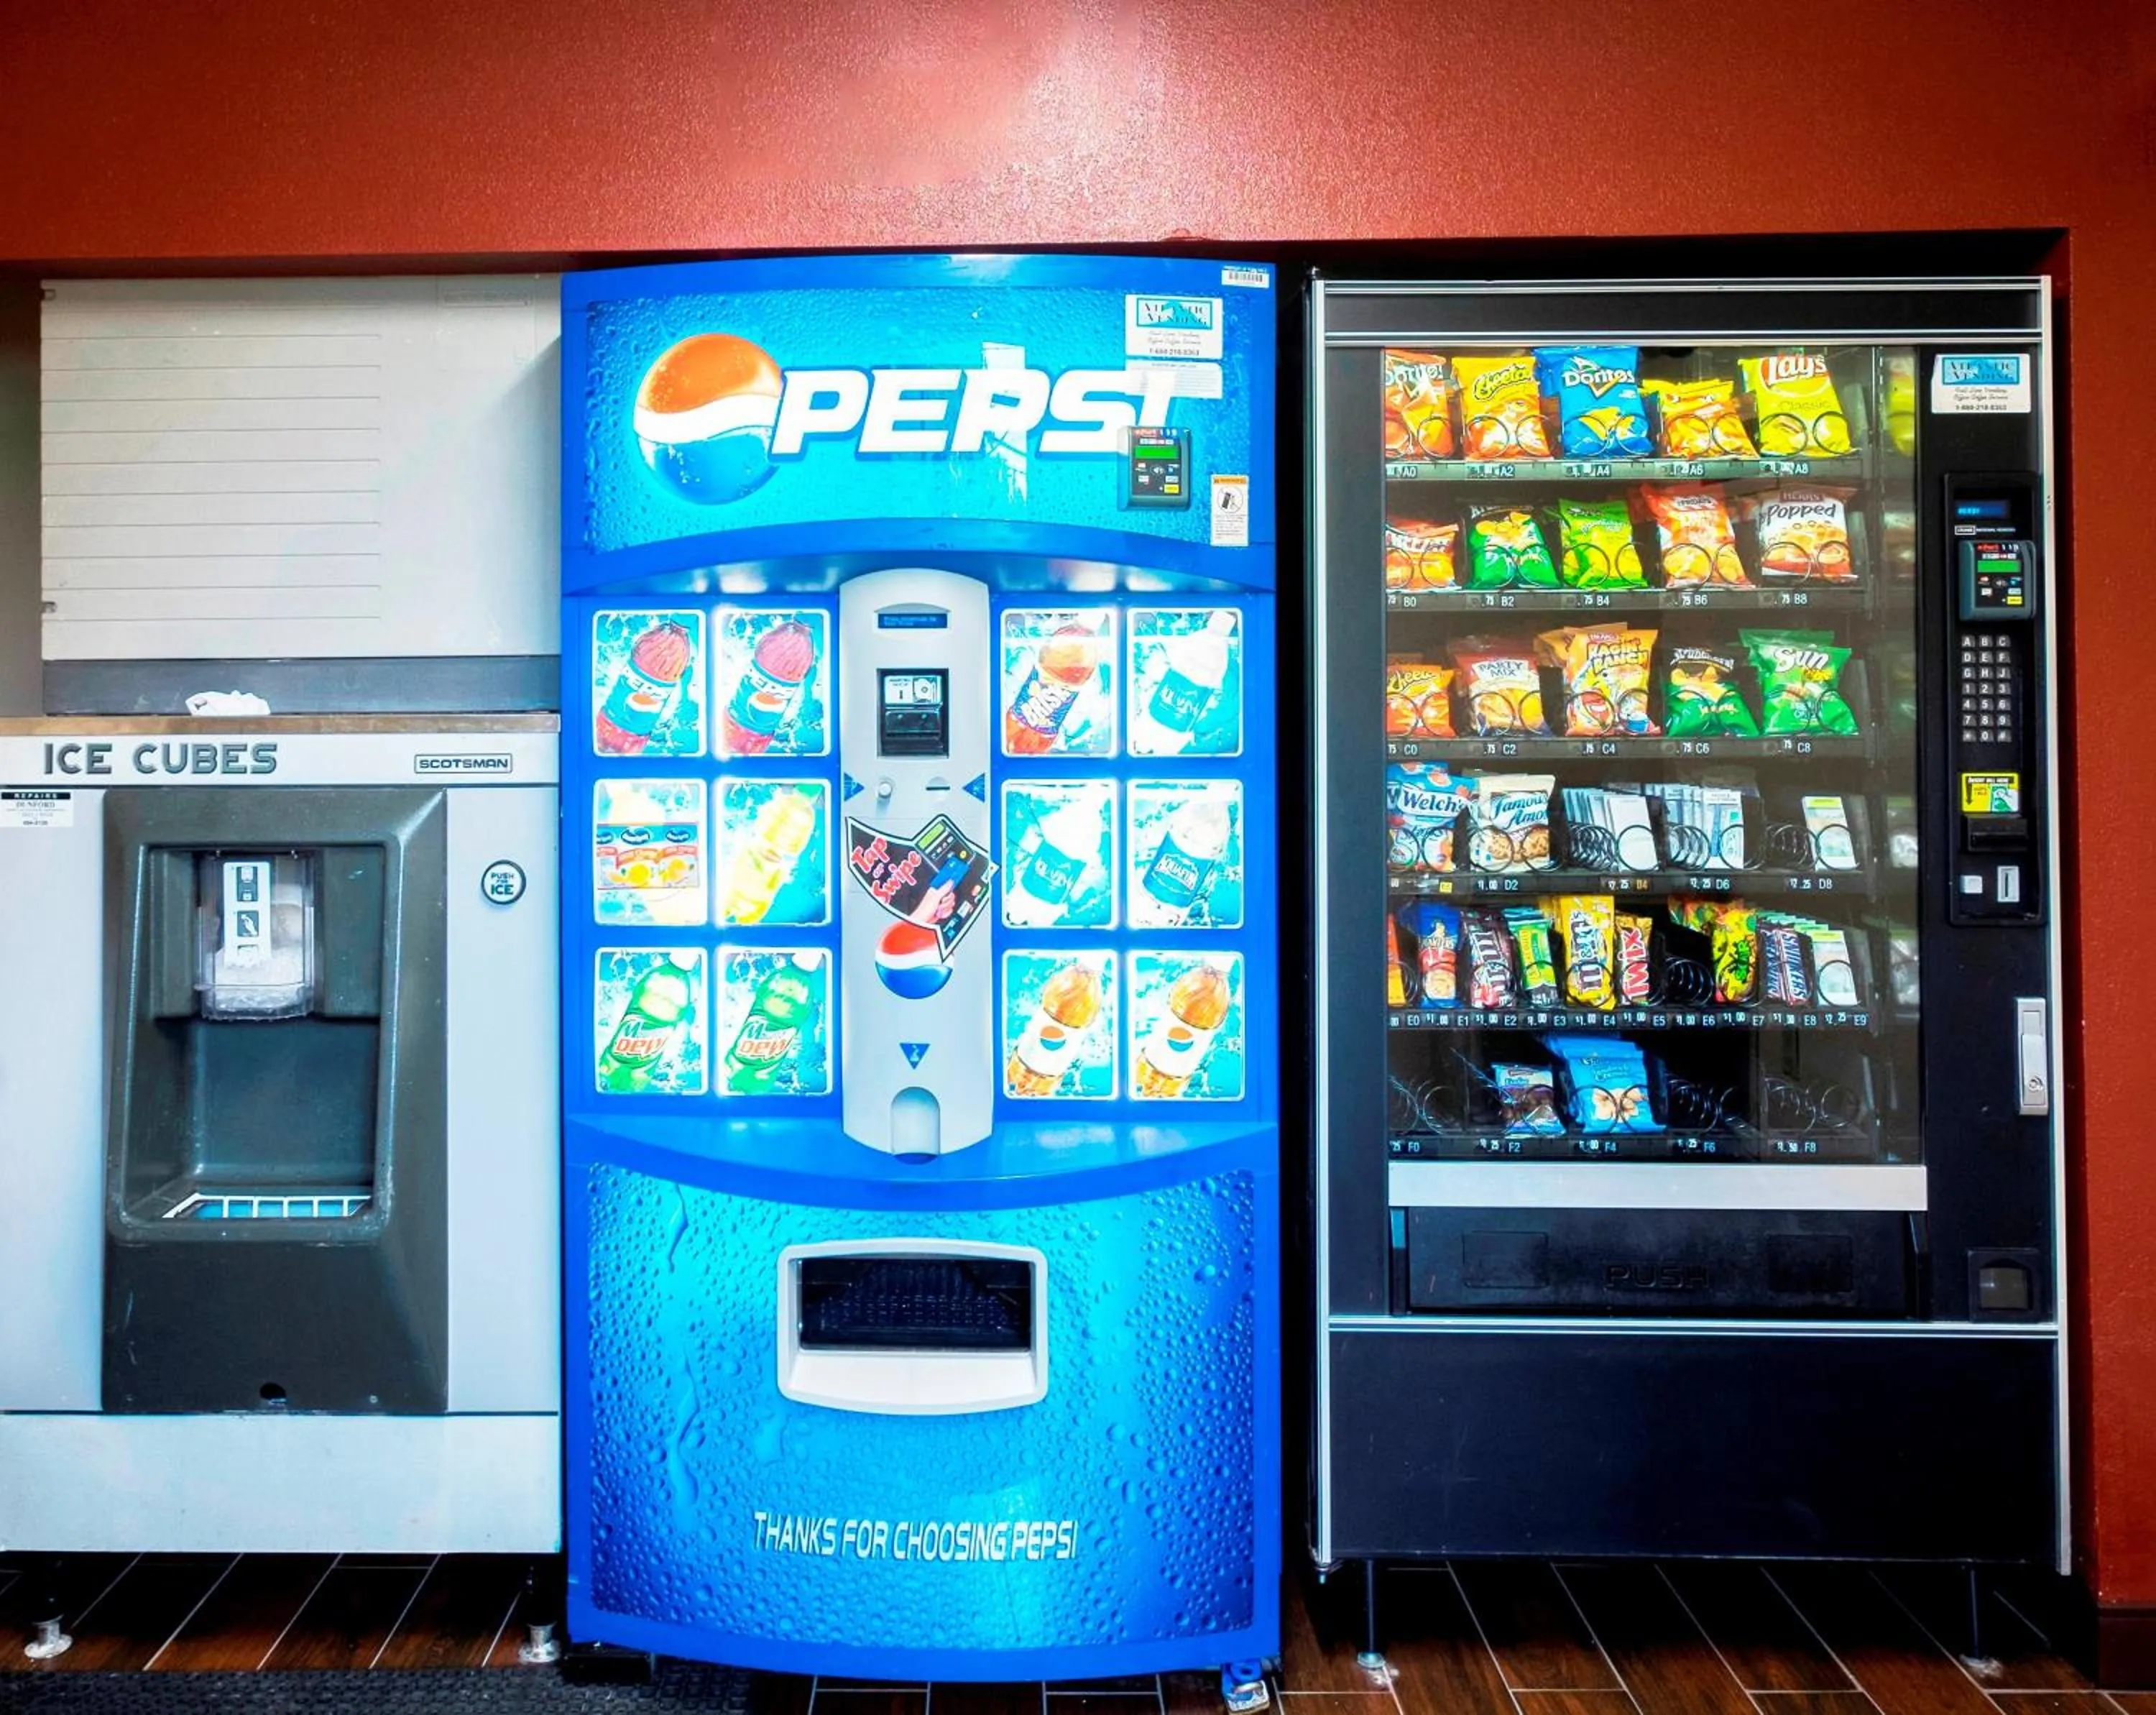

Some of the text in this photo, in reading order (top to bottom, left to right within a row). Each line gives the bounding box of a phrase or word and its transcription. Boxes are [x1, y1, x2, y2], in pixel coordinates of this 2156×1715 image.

[1564, 367, 1635, 387] Doritos
[1402, 466, 1416, 478] A0
[1500, 466, 1514, 477] A2
[1596, 465, 1611, 477] A4
[1690, 464, 1704, 476] A6
[1795, 463, 1809, 474] A8
[1767, 504, 1836, 524] Popped
[1404, 596, 1416, 607] B0
[1501, 595, 1514, 607] B2
[1596, 595, 1610, 606] B4
[1694, 594, 1708, 605] B6
[1794, 594, 1807, 604] B8
[1963, 638, 2006, 646] A B C
[1774, 648, 1829, 672] Sun
[1964, 653, 2006, 662] D E F
[1478, 660, 1525, 673] PARTY
[1491, 668, 1516, 679] MIX
[1964, 668, 2006, 678] G H J
[1981, 684, 1989, 694] 2
[1999, 684, 2006, 694] 3
[1963, 700, 2006, 709] 4 5 6
[1964, 715, 1971, 725] 7
[1999, 715, 2006, 725] 9
[1981, 731, 1989, 740] 0
[1404, 744, 1418, 755] C0
[1503, 744, 1516, 755] C2
[1602, 743, 1616, 755] C4
[1695, 742, 1710, 754] C6
[1797, 742, 1811, 753] C8
[44, 742, 278, 775] ICE CUBES
[419, 758, 508, 769] SCOTSMAN
[1493, 791, 1549, 820] Famous
[850, 835, 891, 874] Tap
[871, 850, 922, 905] Swipe
[1504, 880, 1519, 891] D2
[1715, 879, 1730, 890] D6
[1818, 878, 1833, 889] D8
[491, 884, 514, 896] ICE
[1617, 927, 1650, 1005] TWIX
[1407, 1015, 1419, 1026] E0
[1457, 1016, 1469, 1026] E1
[1504, 1014, 1517, 1026] E2
[1554, 1015, 1566, 1026] E3
[1603, 1015, 1616, 1026] E4
[1653, 1015, 1665, 1026] E5
[1703, 1015, 1715, 1026] E6
[1752, 1015, 1765, 1026] E7
[1804, 1014, 1817, 1026] E8
[1854, 1014, 1866, 1026] E9
[1408, 1141, 1420, 1152] F0
[1508, 1141, 1521, 1153] F2
[1604, 1141, 1616, 1153] F4
[1703, 1141, 1715, 1153] F6
[1805, 1141, 1816, 1153] F8
[1606, 1264, 1708, 1288] PUSH
[753, 1511, 1079, 1562] THANKS FOR CHOOSING PEPSI
